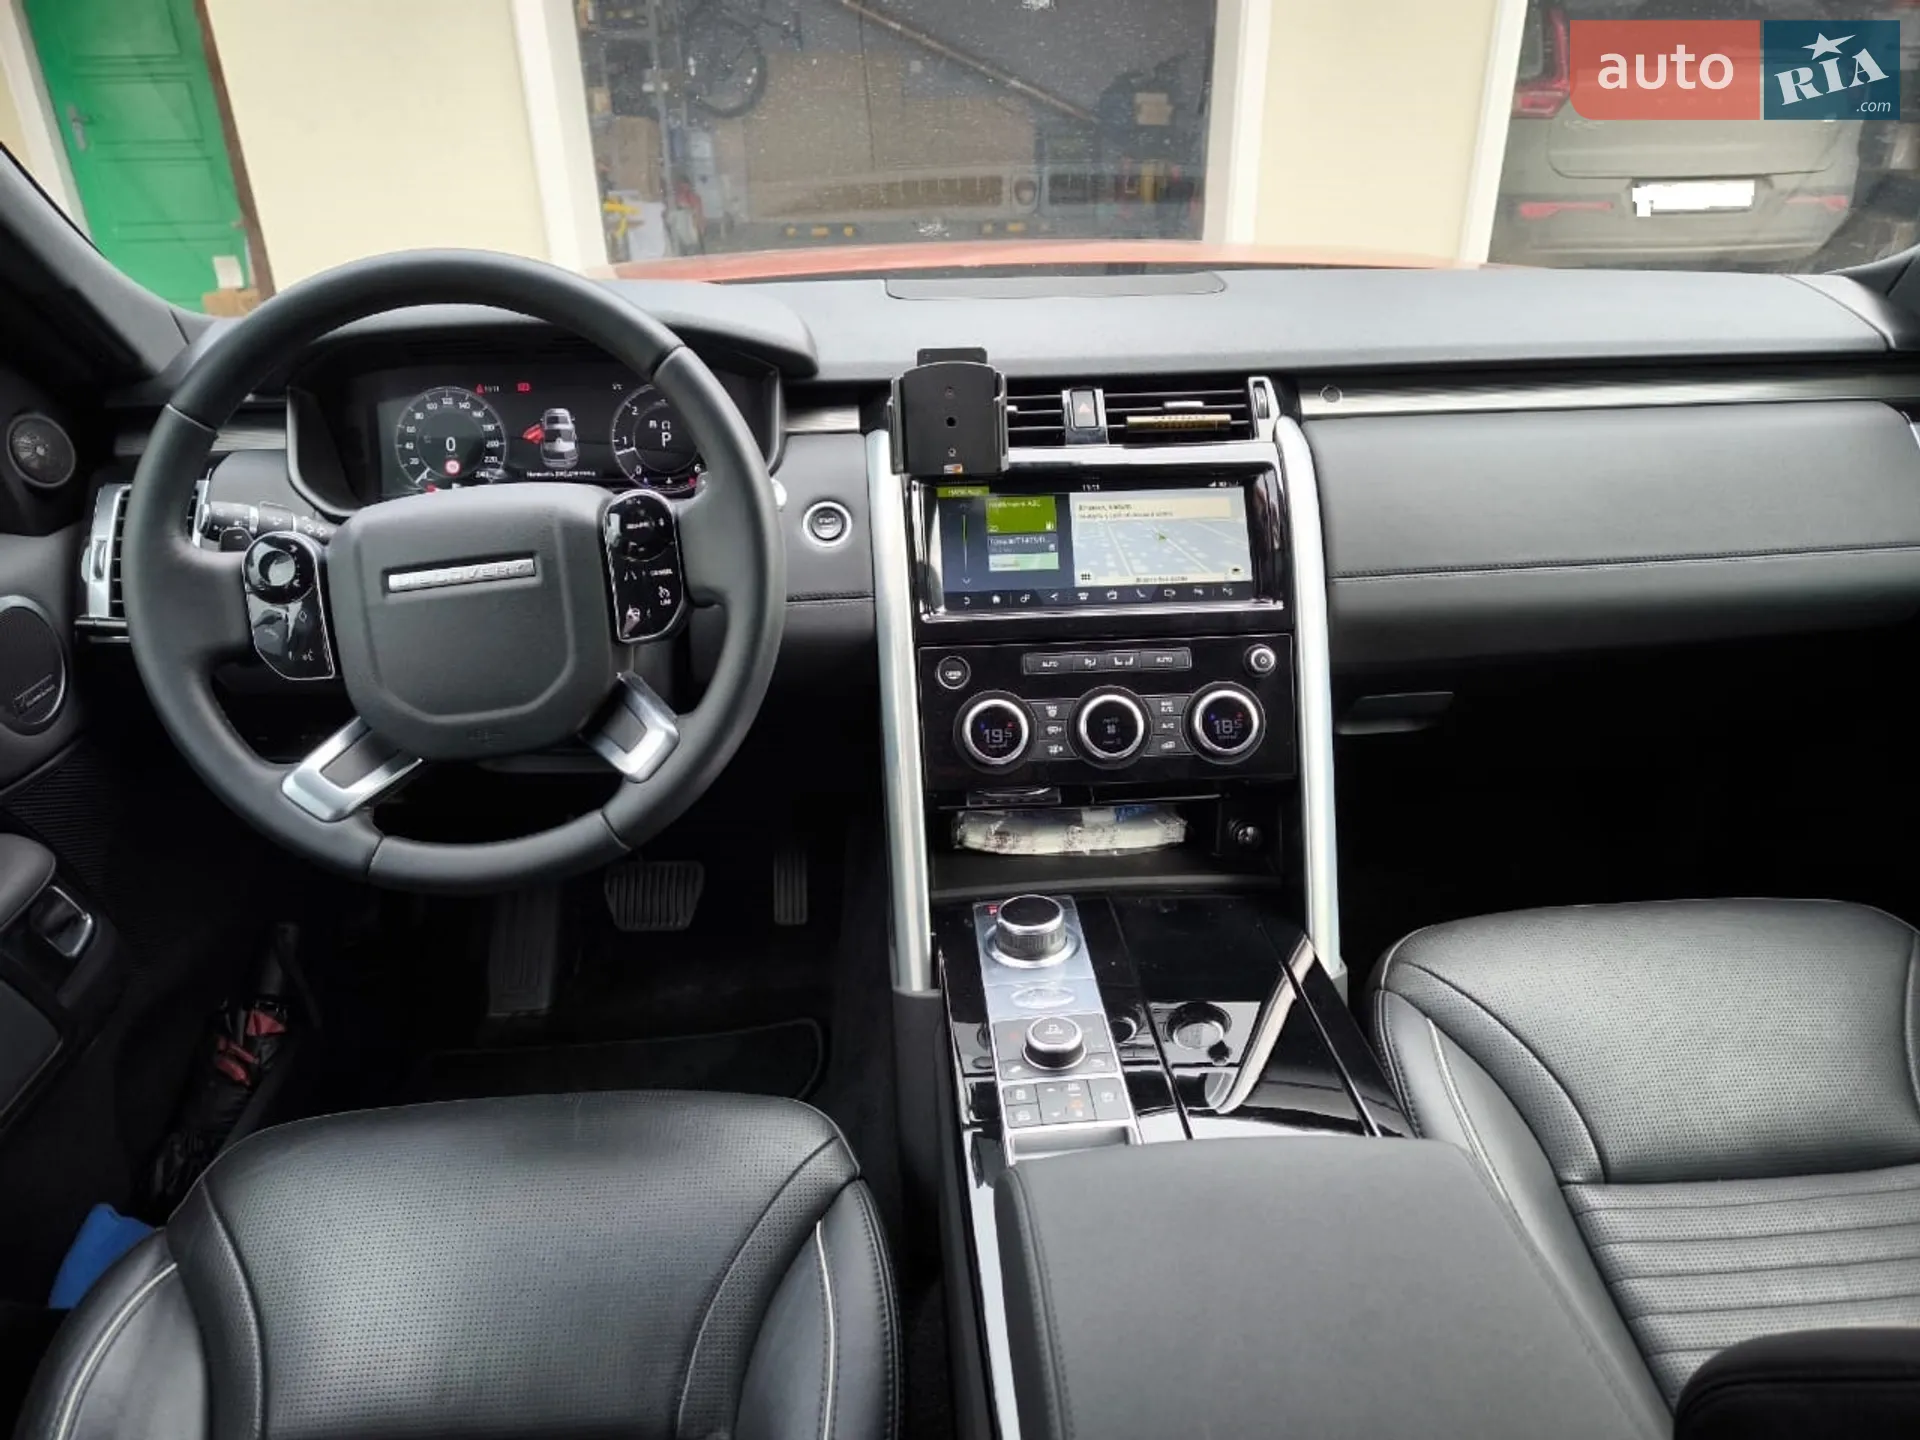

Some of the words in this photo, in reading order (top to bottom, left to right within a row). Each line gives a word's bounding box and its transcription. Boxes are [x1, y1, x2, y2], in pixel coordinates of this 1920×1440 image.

[632, 407, 638, 416] 2
[446, 437, 456, 451] 0
[661, 432, 672, 447] P
[635, 466, 642, 475] 0
[694, 464, 701, 473] 6
